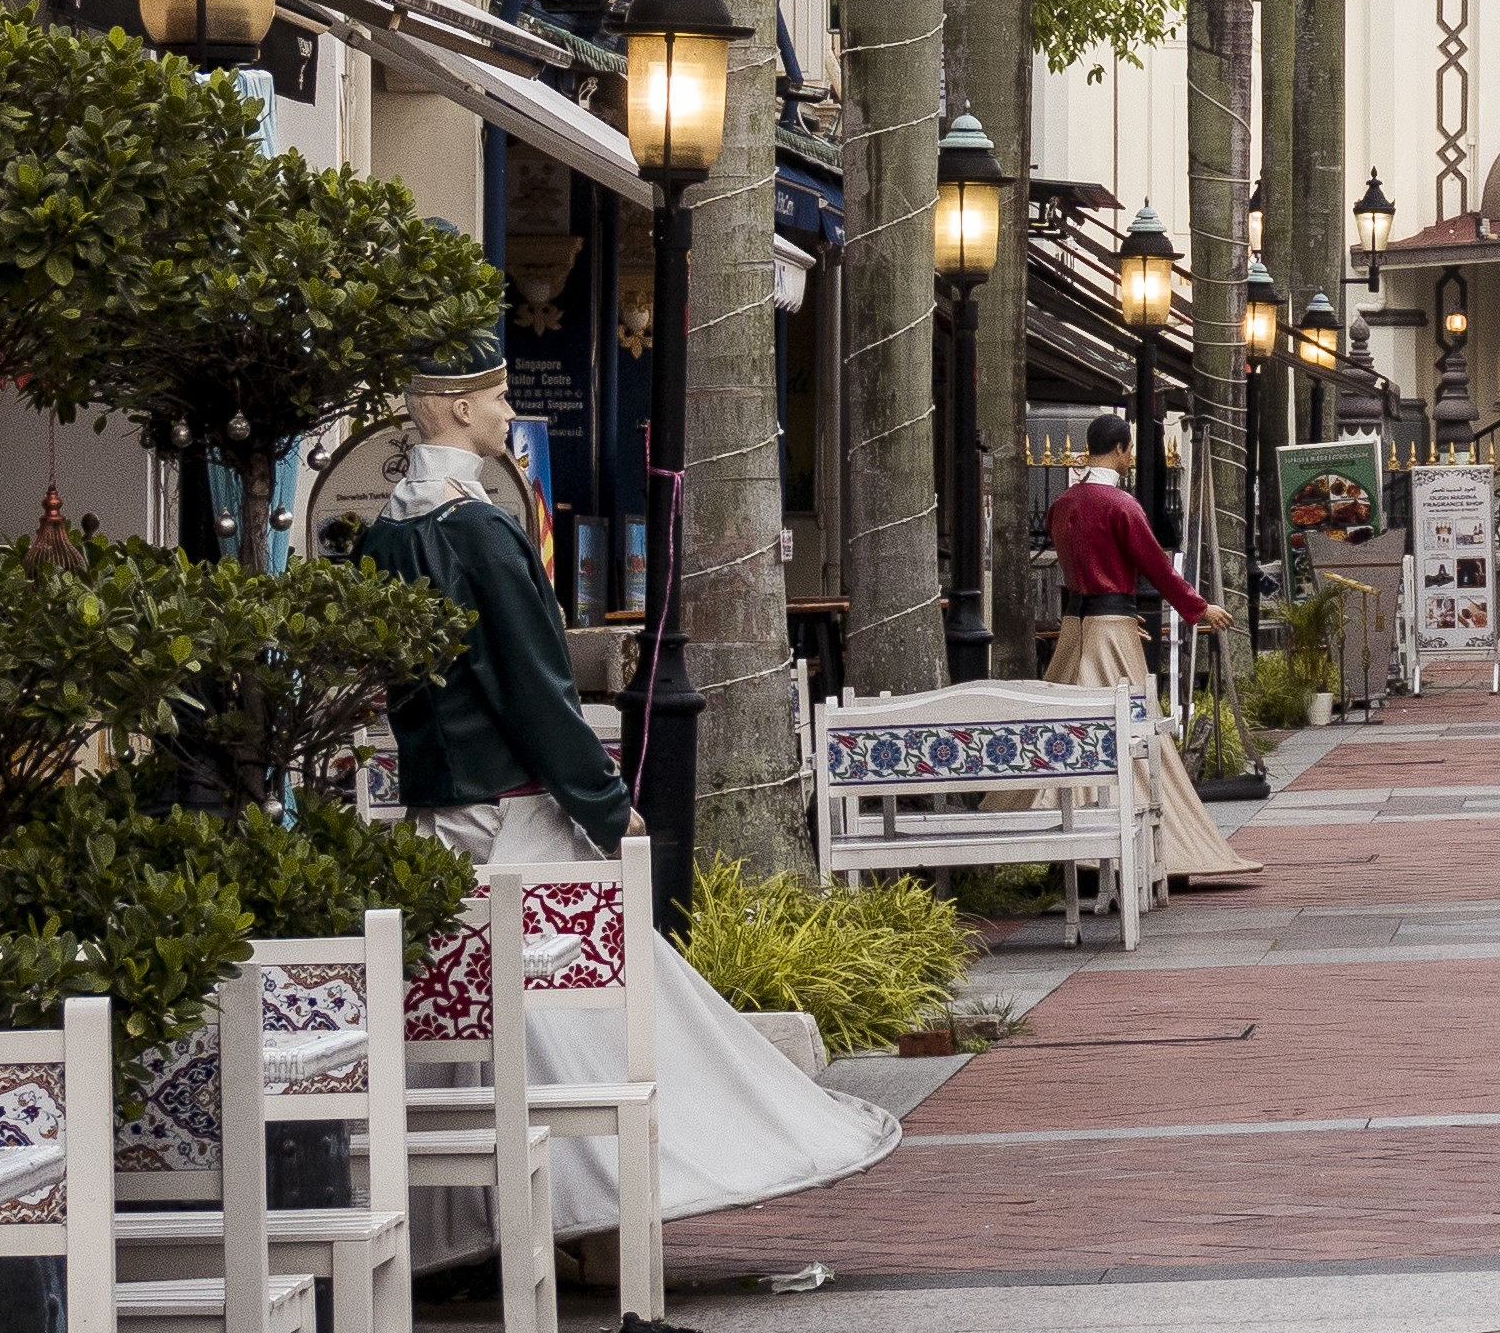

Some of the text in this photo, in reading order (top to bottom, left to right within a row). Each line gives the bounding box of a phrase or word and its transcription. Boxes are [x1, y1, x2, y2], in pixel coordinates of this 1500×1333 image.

[515, 358, 562, 372] Singapore
[541, 373, 572, 385] Centre
[336, 491, 391, 502] Derwish Turki
